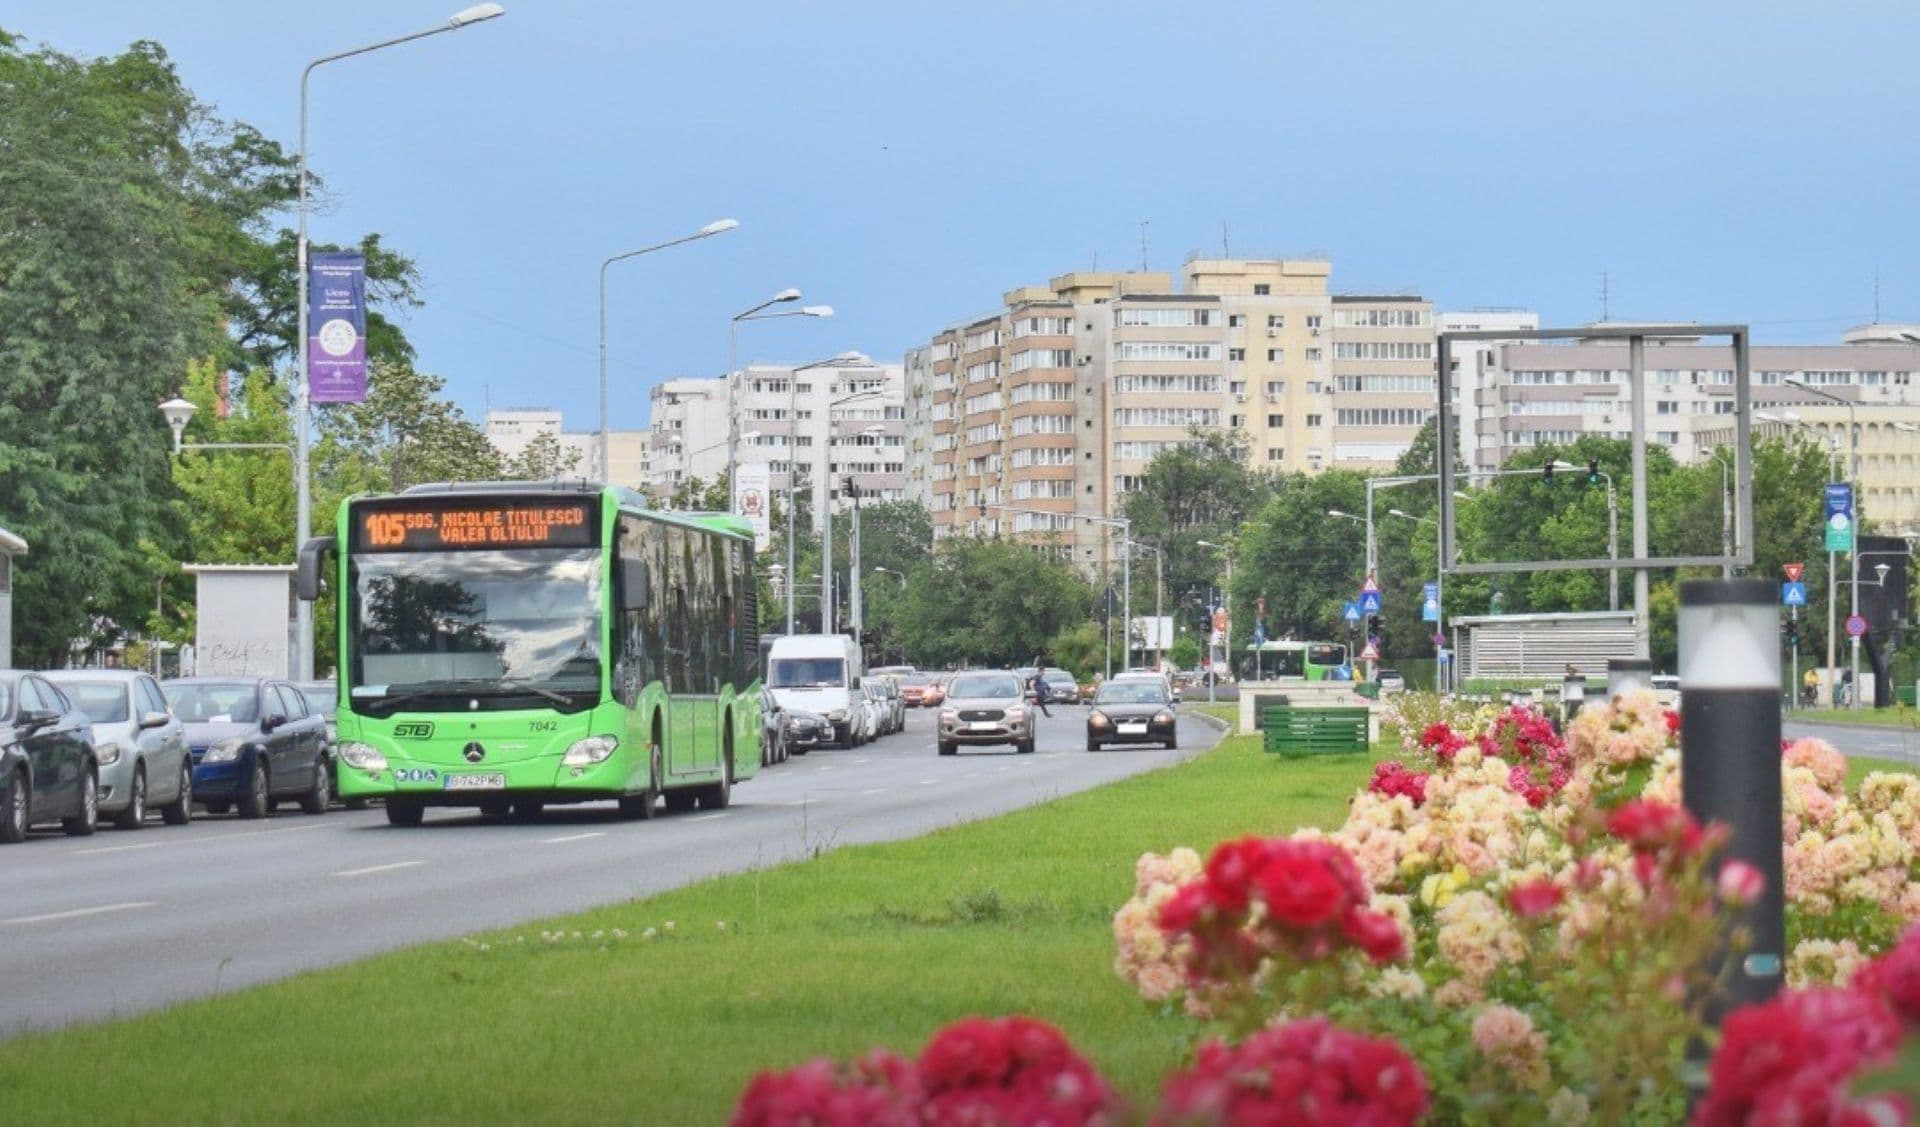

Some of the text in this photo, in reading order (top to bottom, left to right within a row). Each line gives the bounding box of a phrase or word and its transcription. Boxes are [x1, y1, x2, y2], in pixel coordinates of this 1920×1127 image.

[406, 507, 583, 529] SOS. NICOLAE TITULESCU
[366, 514, 406, 545] 105
[441, 525, 548, 542] VALEA OLTULUI
[393, 723, 432, 738] STB
[530, 721, 557, 732] 7042
